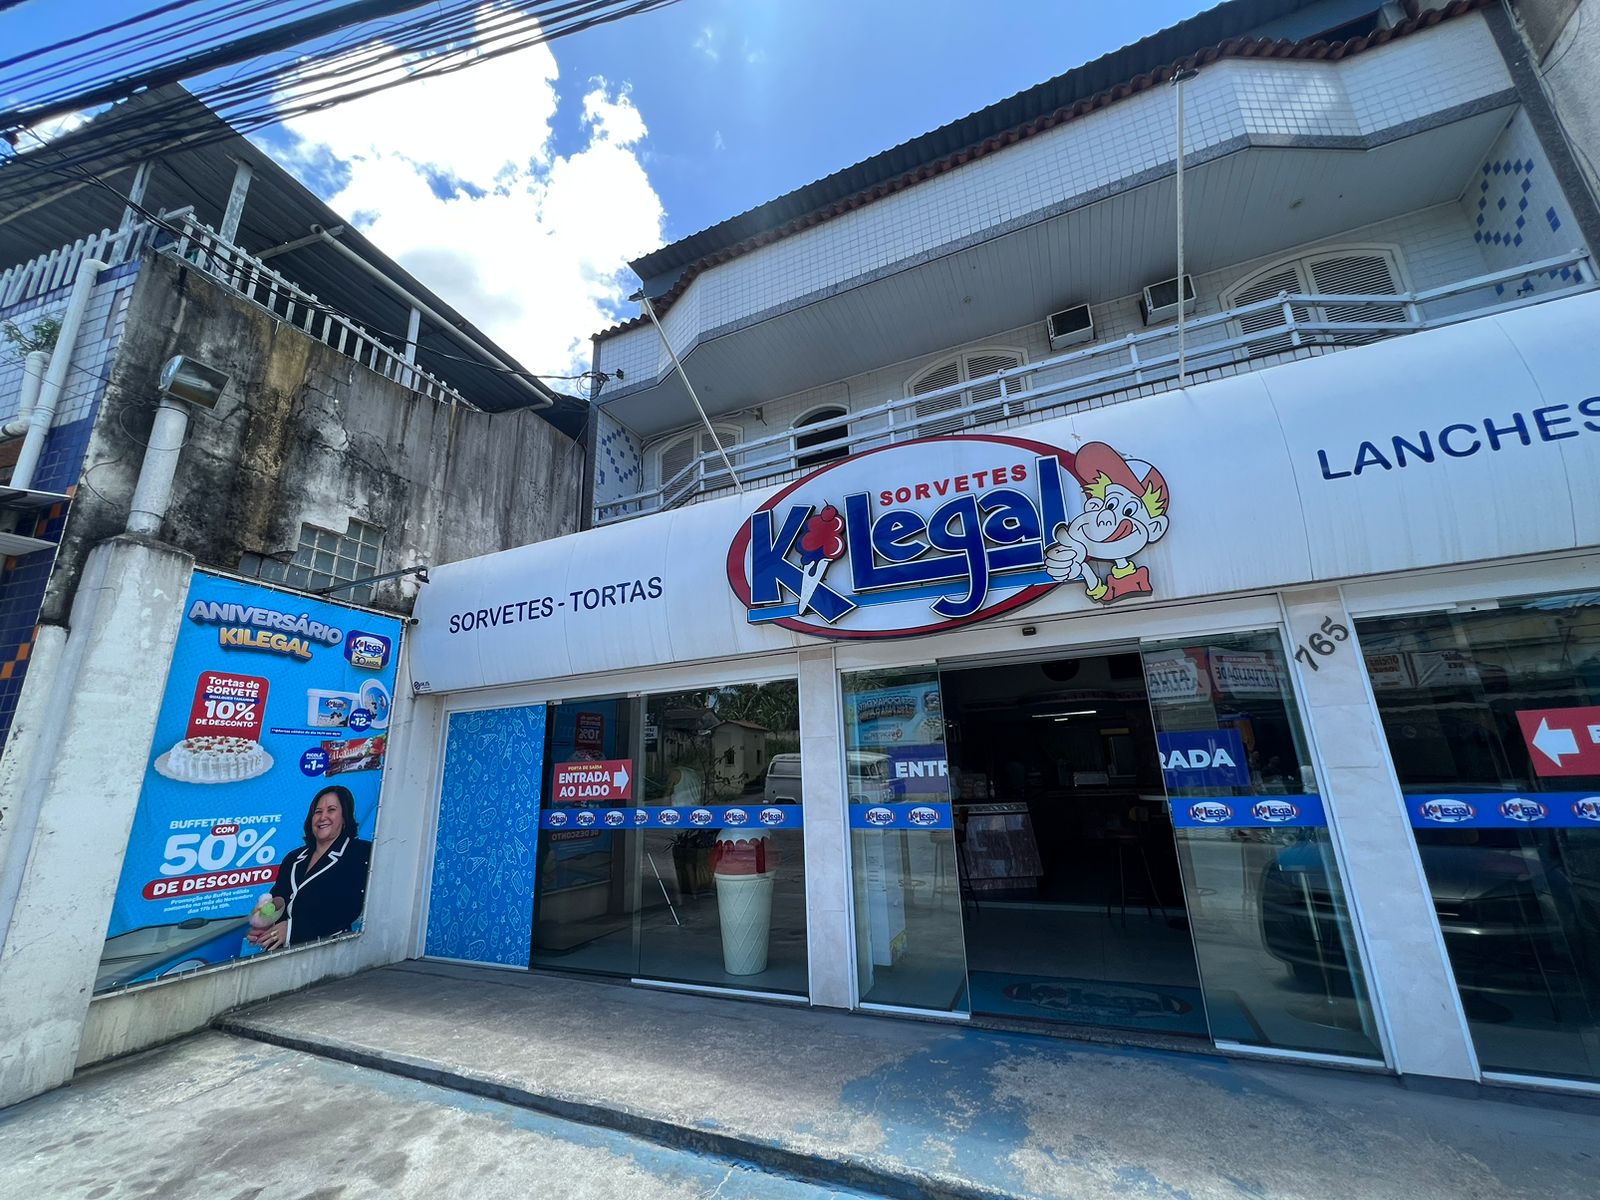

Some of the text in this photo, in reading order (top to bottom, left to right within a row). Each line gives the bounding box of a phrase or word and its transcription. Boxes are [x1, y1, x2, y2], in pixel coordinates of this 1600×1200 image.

[879, 464, 1028, 507] SORVETES
[449, 597, 554, 634] SORVETES
[569, 576, 663, 613] TORTAS
[188, 600, 344, 646] ANIVERSÁRIO
[218, 626, 314, 660] KILEGAL
[1294, 615, 1349, 671] 765
[205, 685, 259, 698] SORVETE
[208, 676, 260, 690] Tortas de
[204, 700, 256, 721] 10%
[195, 718, 208, 726] DE
[558, 771, 611, 784] ENTRADA
[559, 784, 610, 798] AO LADO
[169, 814, 282, 829] BUFFET DE SORVETE
[215, 826, 235, 834] COM
[160, 826, 277, 876] 50%
[153, 868, 273, 896] DE DESCONTO
